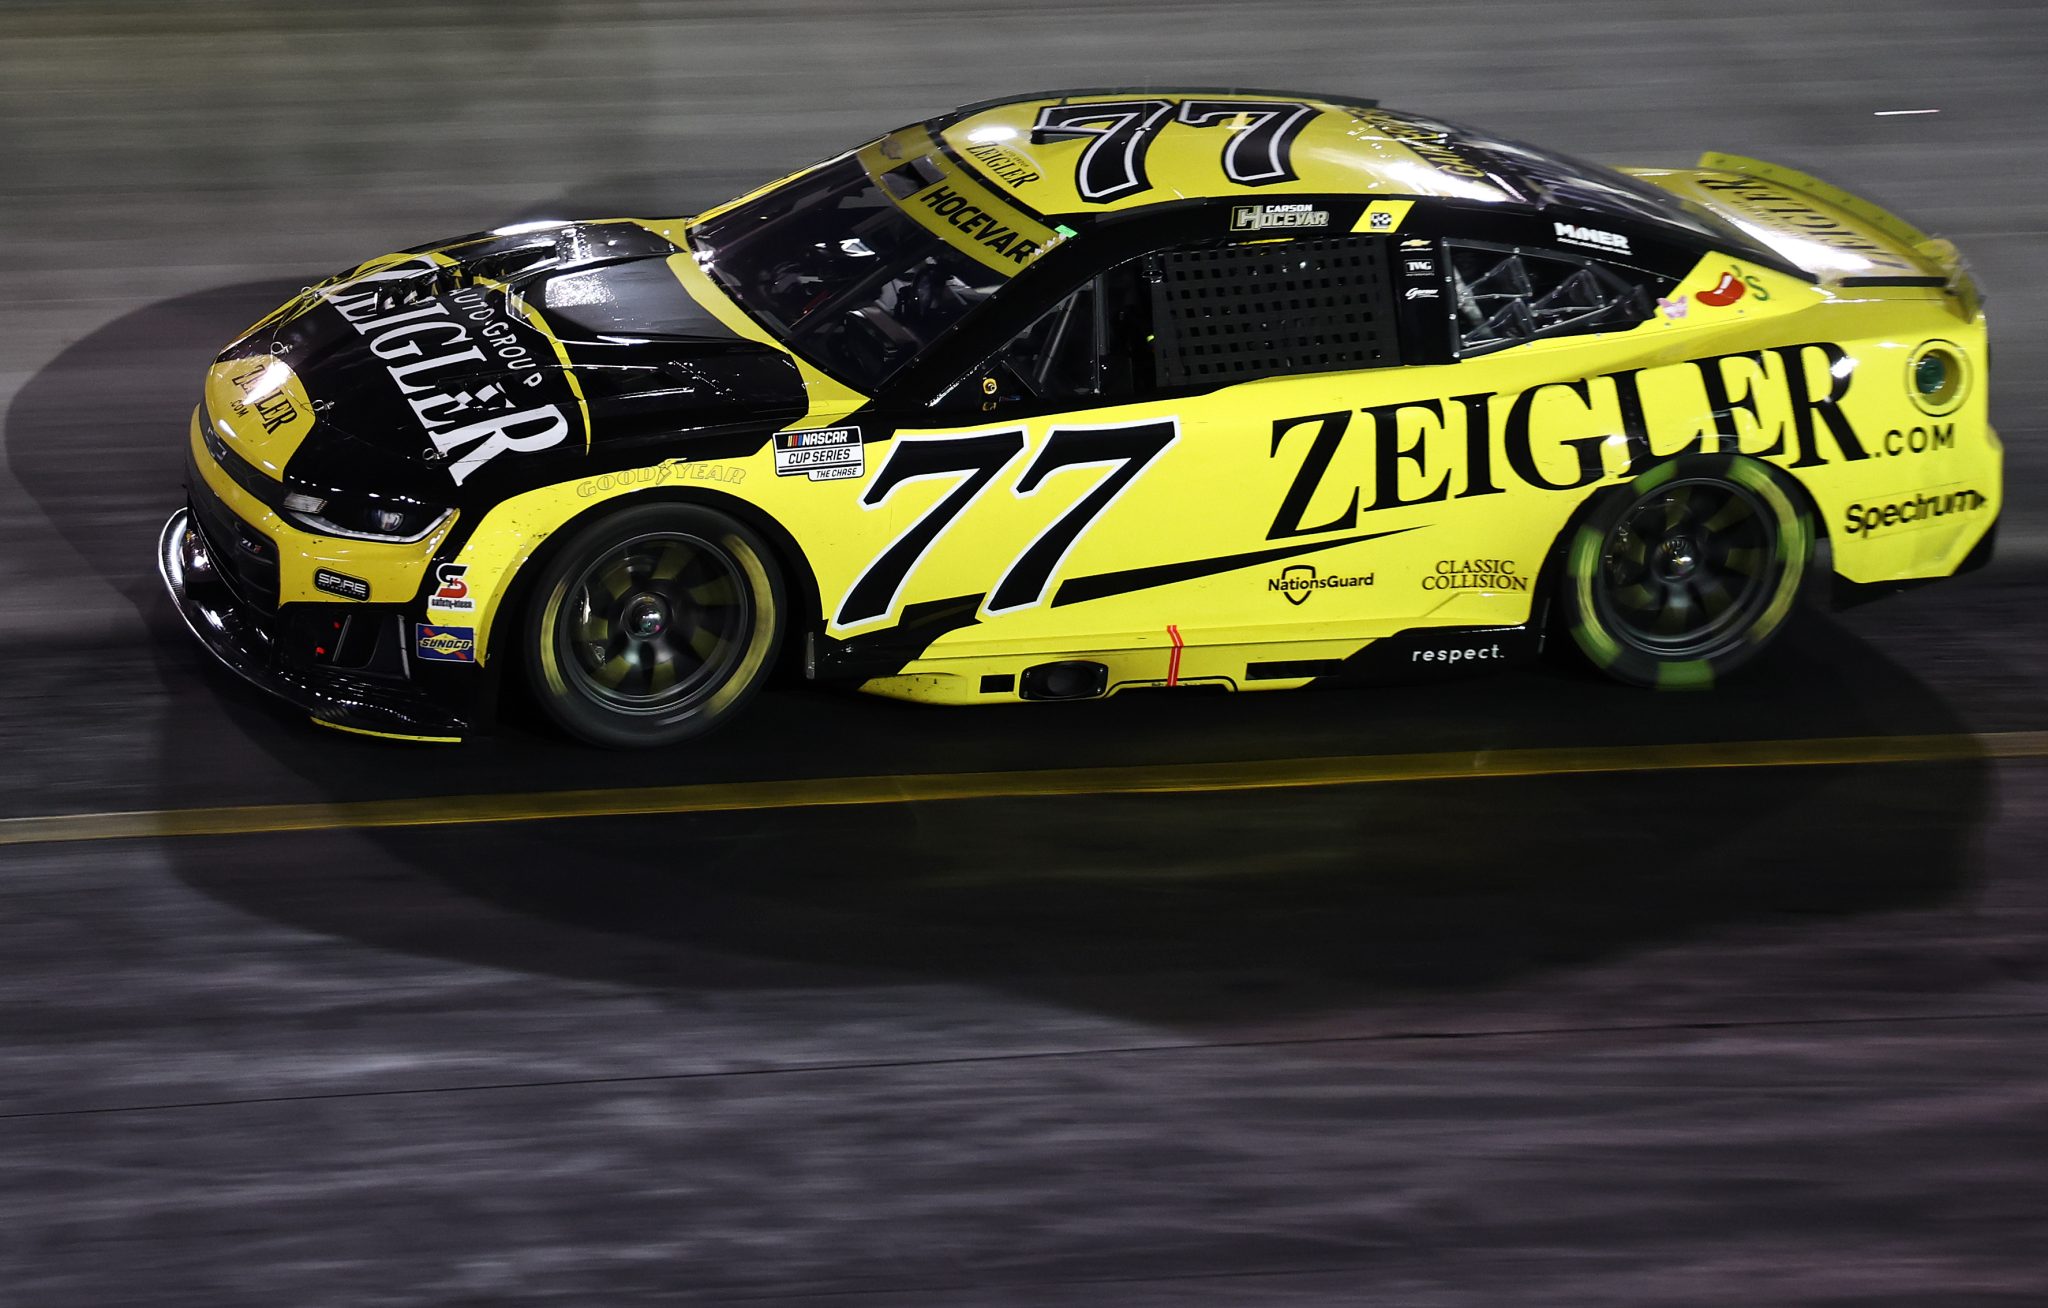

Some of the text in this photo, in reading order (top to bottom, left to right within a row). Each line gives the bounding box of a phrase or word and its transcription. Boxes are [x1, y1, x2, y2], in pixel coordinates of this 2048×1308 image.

[1031, 99, 1324, 204] 77
[965, 142, 1040, 189] ZEIGLER
[1230, 205, 1329, 231] HOCEVAR
[1265, 203, 1313, 213] CARSON
[920, 185, 1042, 264] HOCEVAR
[482, 320, 544, 389] GROUP
[317, 254, 569, 487] ZEIGLER
[231, 364, 298, 435] ZLER
[802, 430, 848, 446] NASCAR
[788, 448, 851, 465] CUP SERIES
[816, 466, 857, 479] THE CHASE
[831, 415, 1181, 631] 77
[1843, 489, 1980, 539] Spectrum
[1435, 559, 1516, 575] CLASSIC
[1267, 572, 1375, 592] NationsGuard
[1421, 574, 1529, 592] COLLISION
[421, 638, 472, 649] SUNOCO
[1412, 643, 1505, 664] respect.
